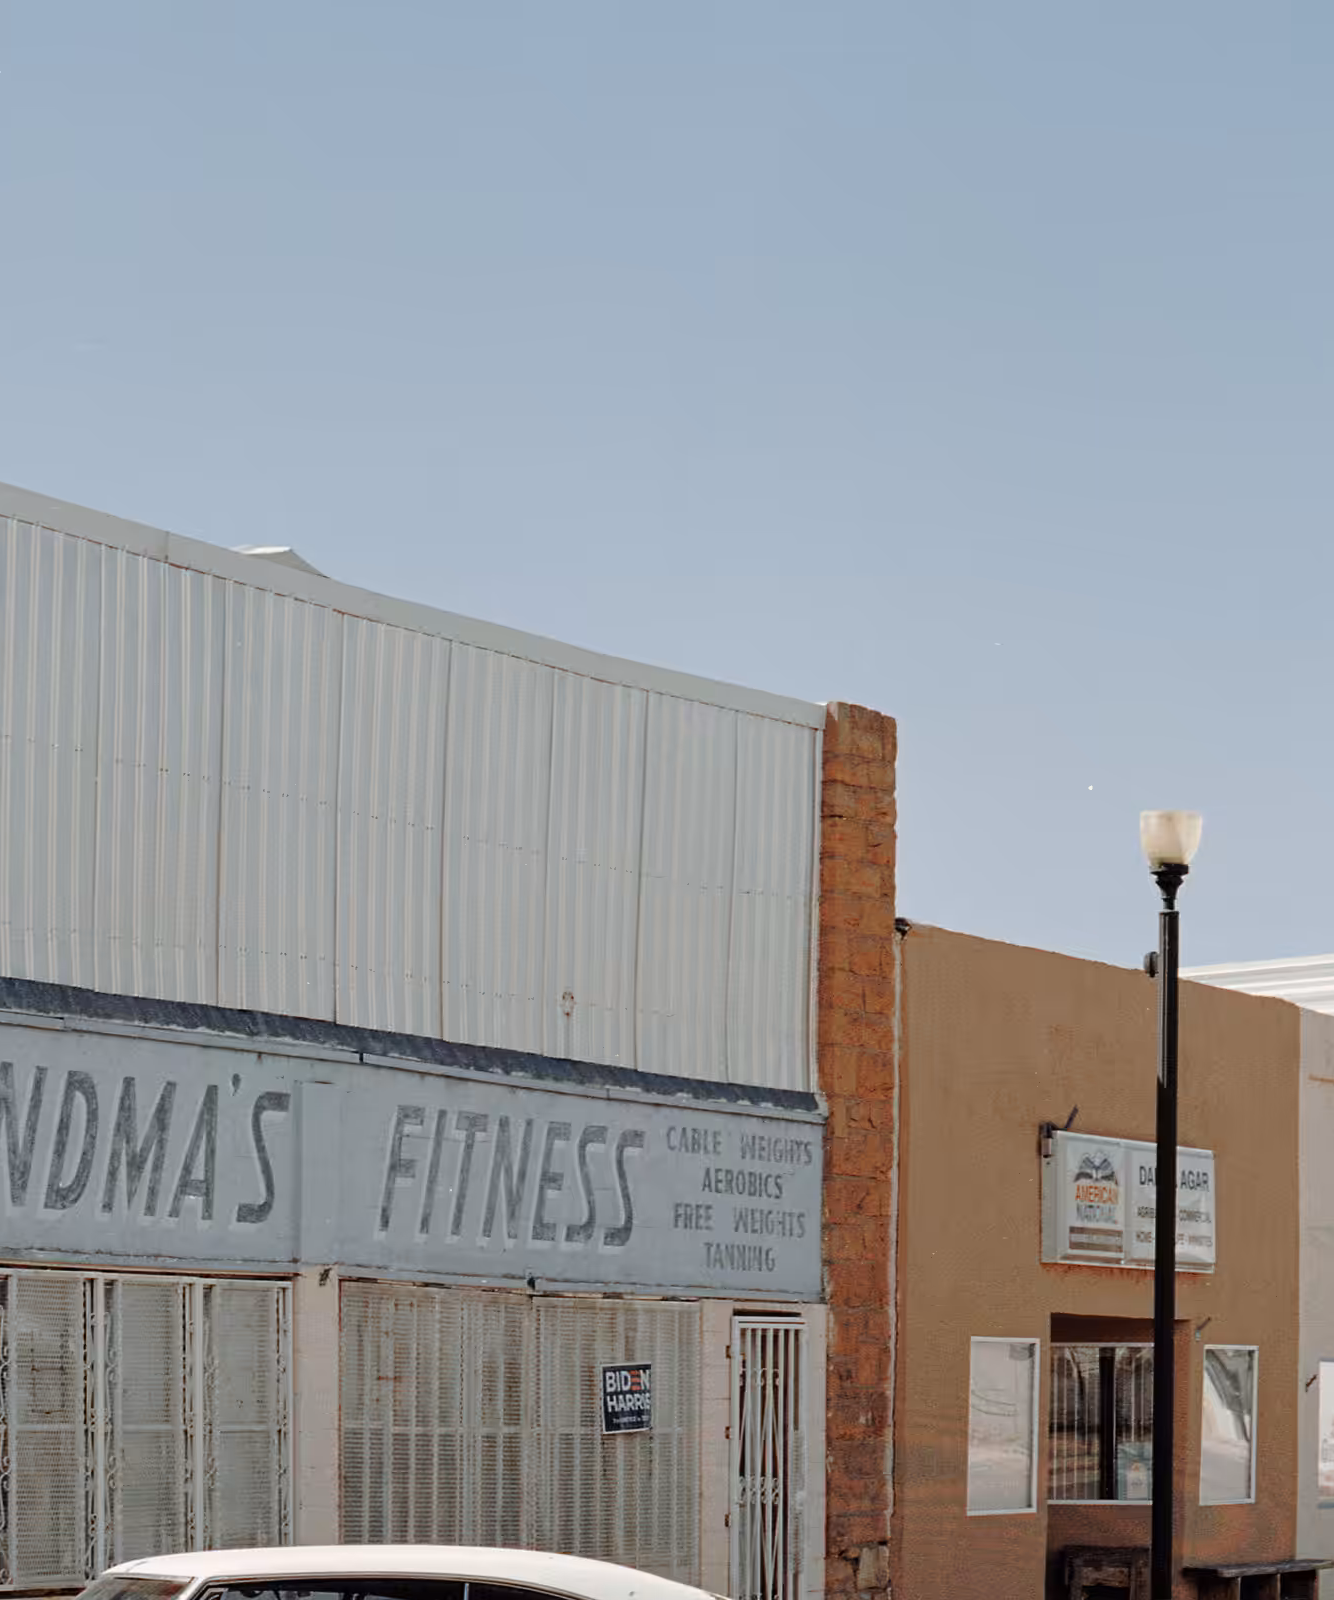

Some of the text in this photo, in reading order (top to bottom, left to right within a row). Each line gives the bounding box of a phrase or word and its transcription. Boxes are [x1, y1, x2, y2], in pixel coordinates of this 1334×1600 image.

[666, 1126, 813, 1165] CABLE WEIGHTS
[379, 1104, 645, 1247] FITNESS
[702, 1167, 784, 1200] AEROBICS
[1180, 1169, 1211, 1192] AGAR
[1075, 1184, 1119, 1205] AMERICAN
[673, 1202, 806, 1239] FREE WEIGHTS
[704, 1242, 776, 1272] TANNING
[605, 1370, 651, 1392] BIDEN
